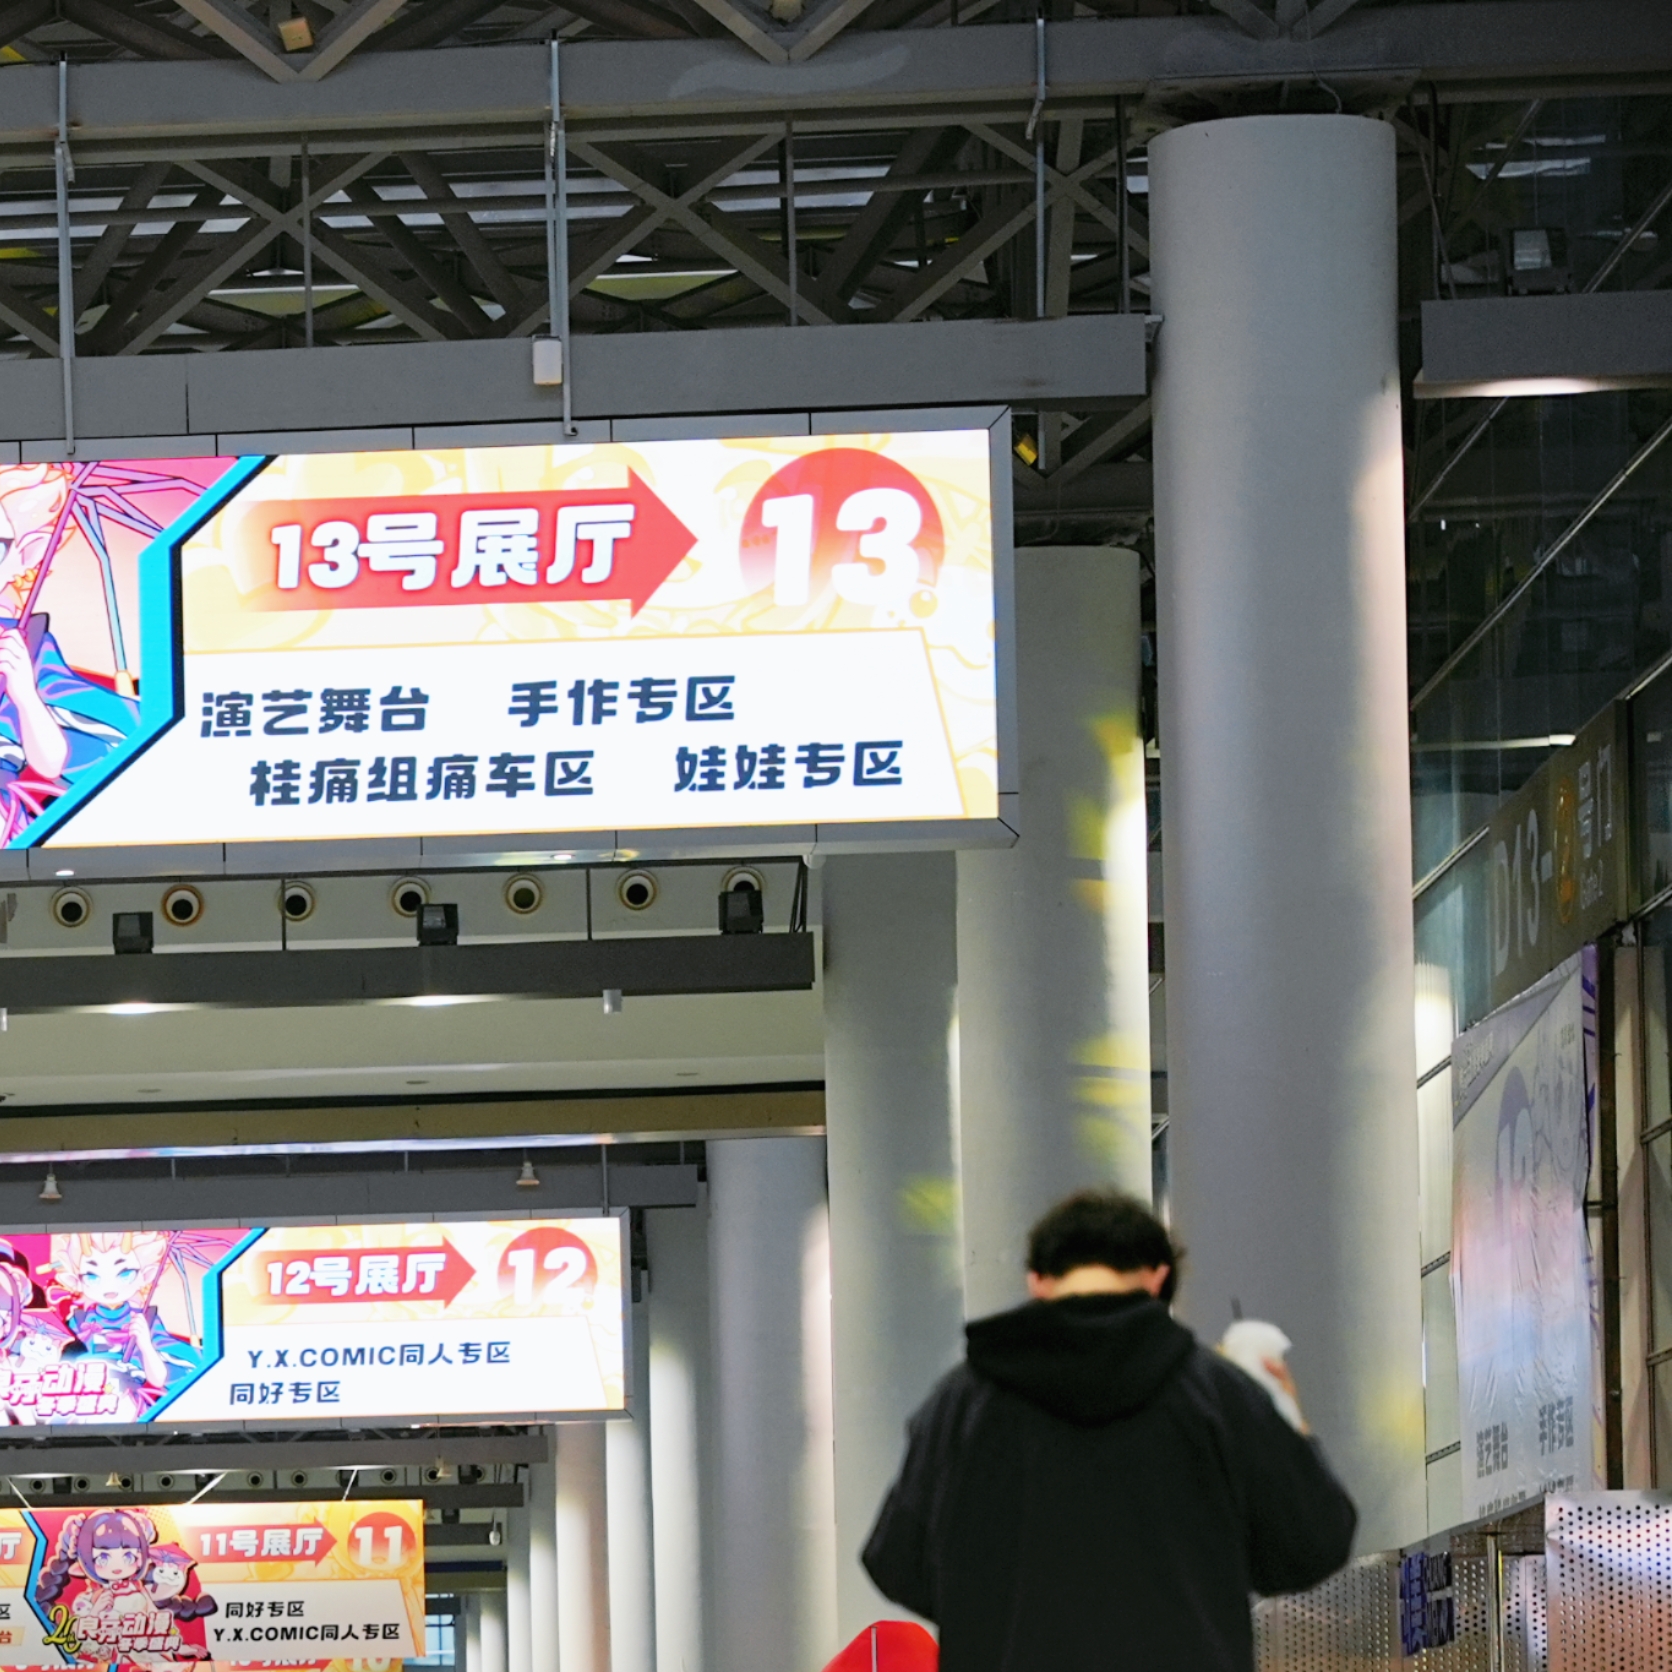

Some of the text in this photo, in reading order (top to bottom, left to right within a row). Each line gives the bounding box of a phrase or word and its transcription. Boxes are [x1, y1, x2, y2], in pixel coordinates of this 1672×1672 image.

[270, 503, 636, 591] 13号展厅
[760, 487, 923, 607] 13
[199, 674, 736, 738] 演艺舞台 手作专区
[249, 739, 904, 807] 桂痛组痛车区 娃娃专区
[266, 1252, 447, 1297] 12号展厅
[506, 1246, 588, 1306] 12
[247, 1340, 512, 1369] Y.X.COMIC同人专区
[229, 1380, 342, 1406] 同好专区
[199, 1527, 324, 1558] 11号展厅
[354, 1525, 403, 1566] 11
[225, 1600, 305, 1619] 同好专区
[213, 1623, 400, 1642] Y.X.COMIC同人专区
